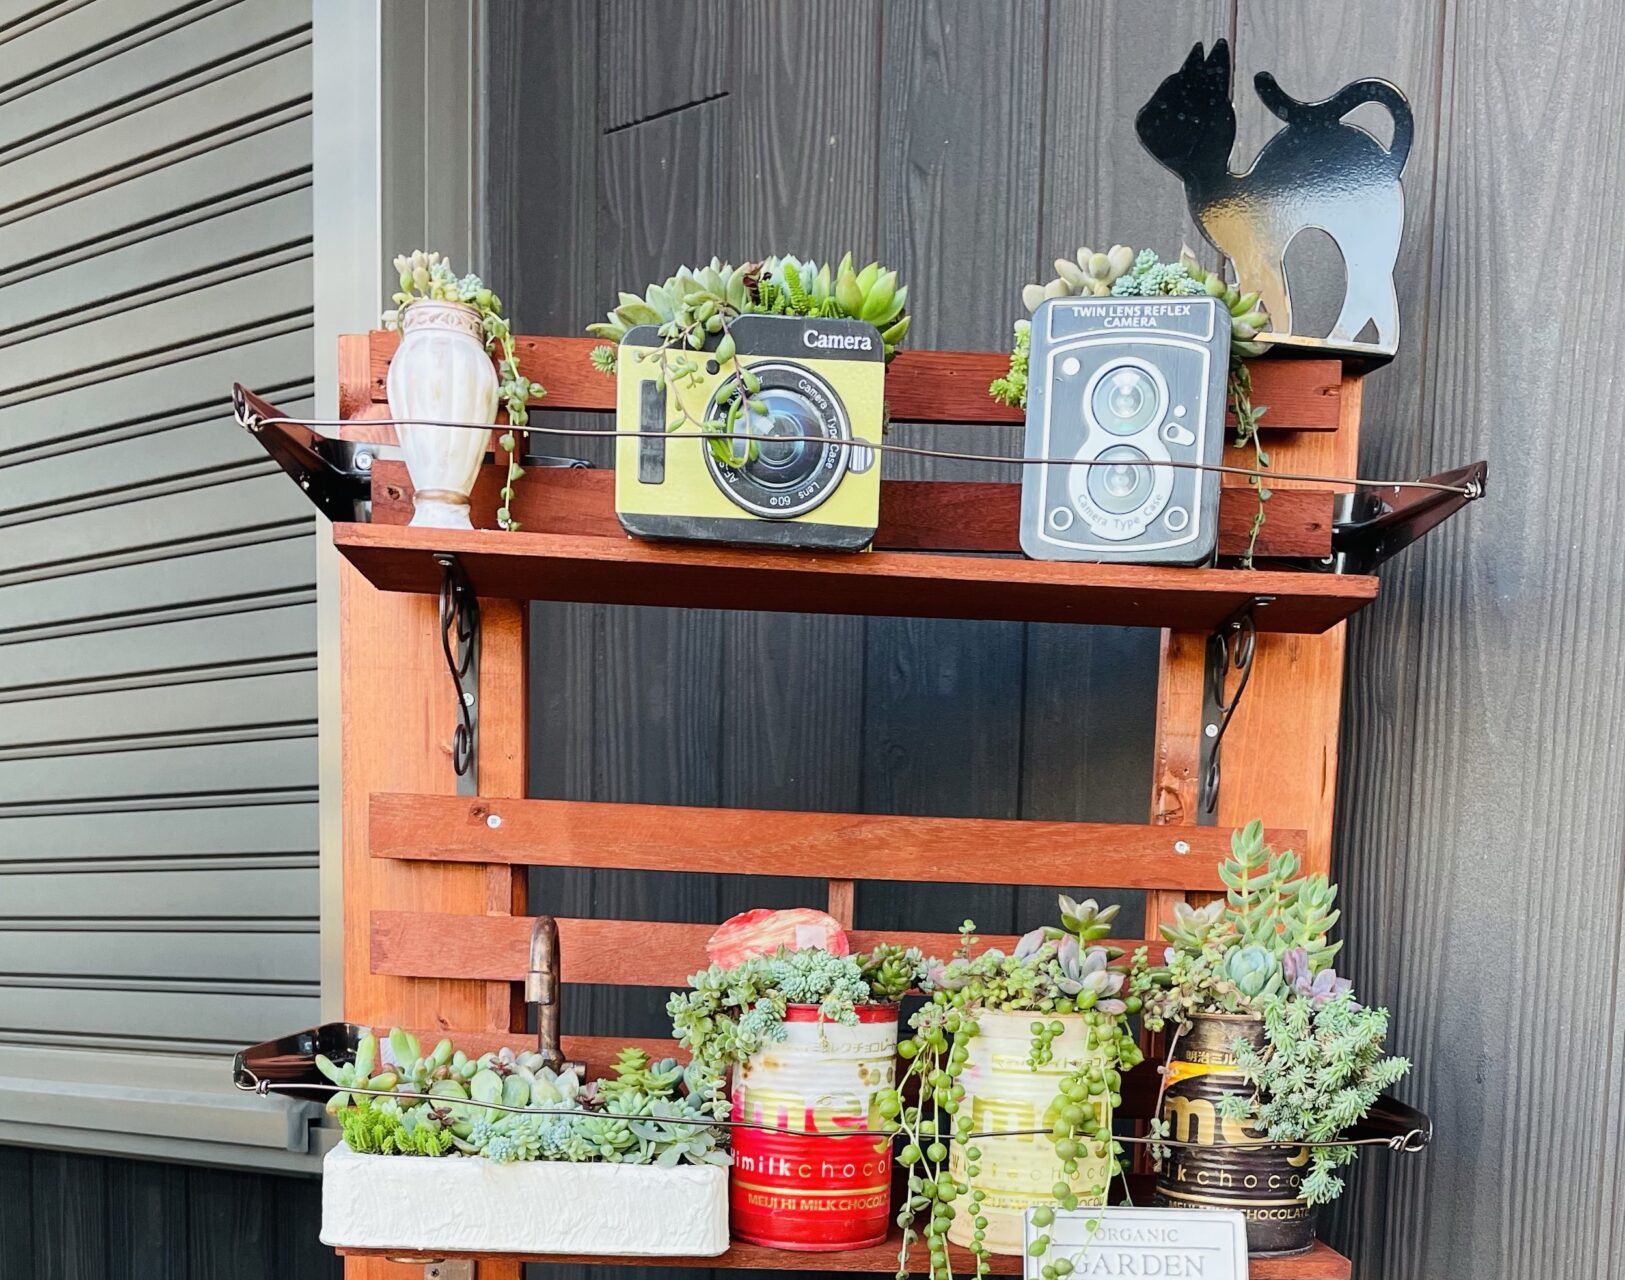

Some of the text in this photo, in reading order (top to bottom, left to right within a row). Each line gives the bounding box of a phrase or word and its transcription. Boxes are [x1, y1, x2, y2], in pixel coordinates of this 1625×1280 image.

[1072, 304, 1191, 317] TWIN LENS REFLEX
[1103, 317, 1158, 328] CAMERA
[803, 329, 873, 351] Camera
[798, 379, 828, 411] Camera
[825, 444, 840, 469] Case
[798, 482, 820, 499] Lens
[1077, 494, 1108, 527] Camera
[1114, 517, 1141, 531] Type
[748, 1194, 778, 1210] MEIJI
[781, 1198, 796, 1210] HI
[800, 1199, 836, 1211] MILK
[1094, 1228, 1179, 1242] ORGANIC
[1070, 1252, 1205, 1277] GARDEN
